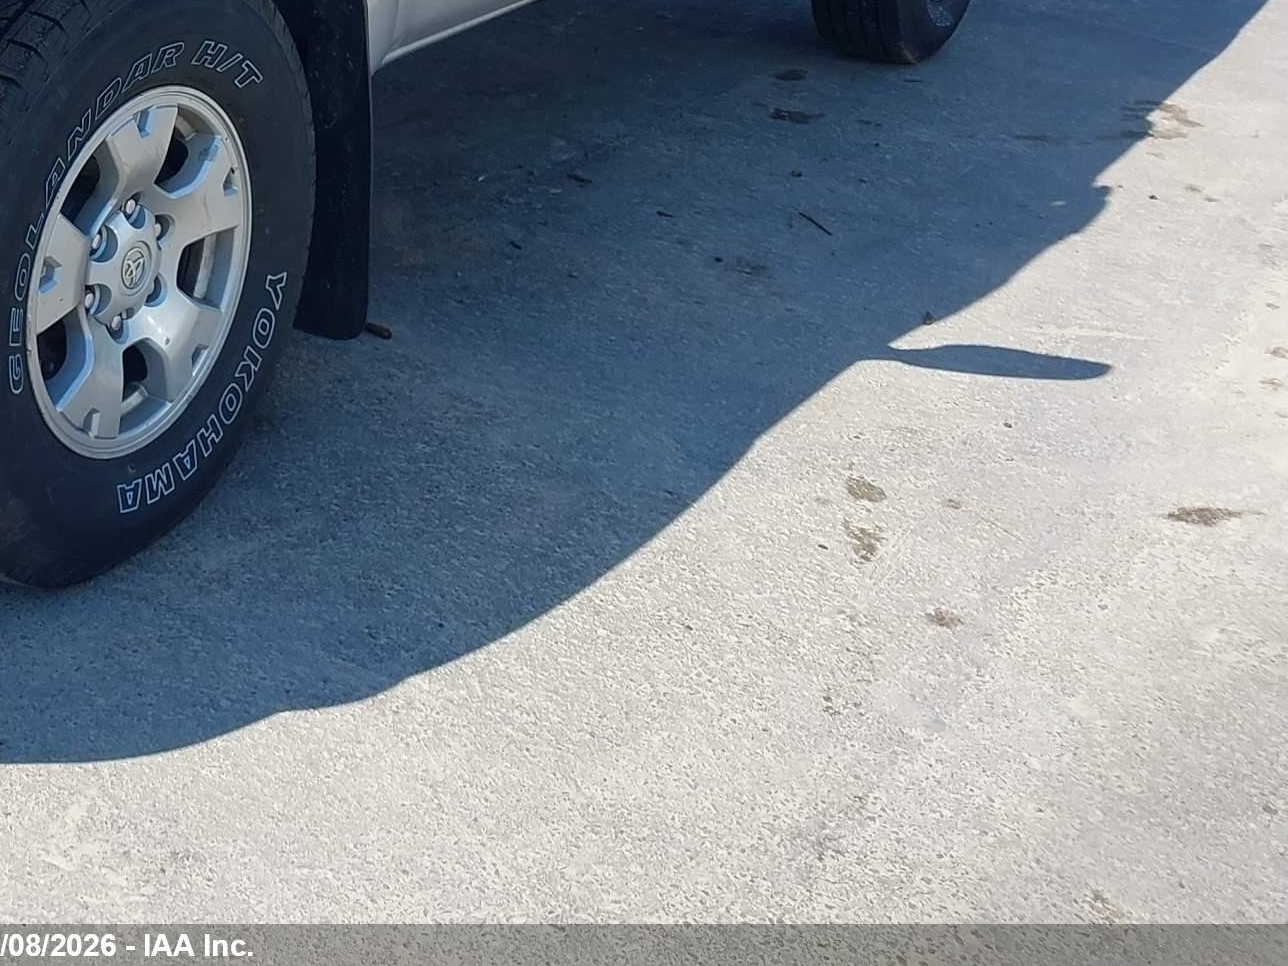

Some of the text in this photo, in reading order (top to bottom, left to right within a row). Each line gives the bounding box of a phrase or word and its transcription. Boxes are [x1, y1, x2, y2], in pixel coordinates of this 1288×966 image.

[8, 40, 264, 394] GEOLANDAR H/T
[117, 272, 287, 513] YOKOHAMA
